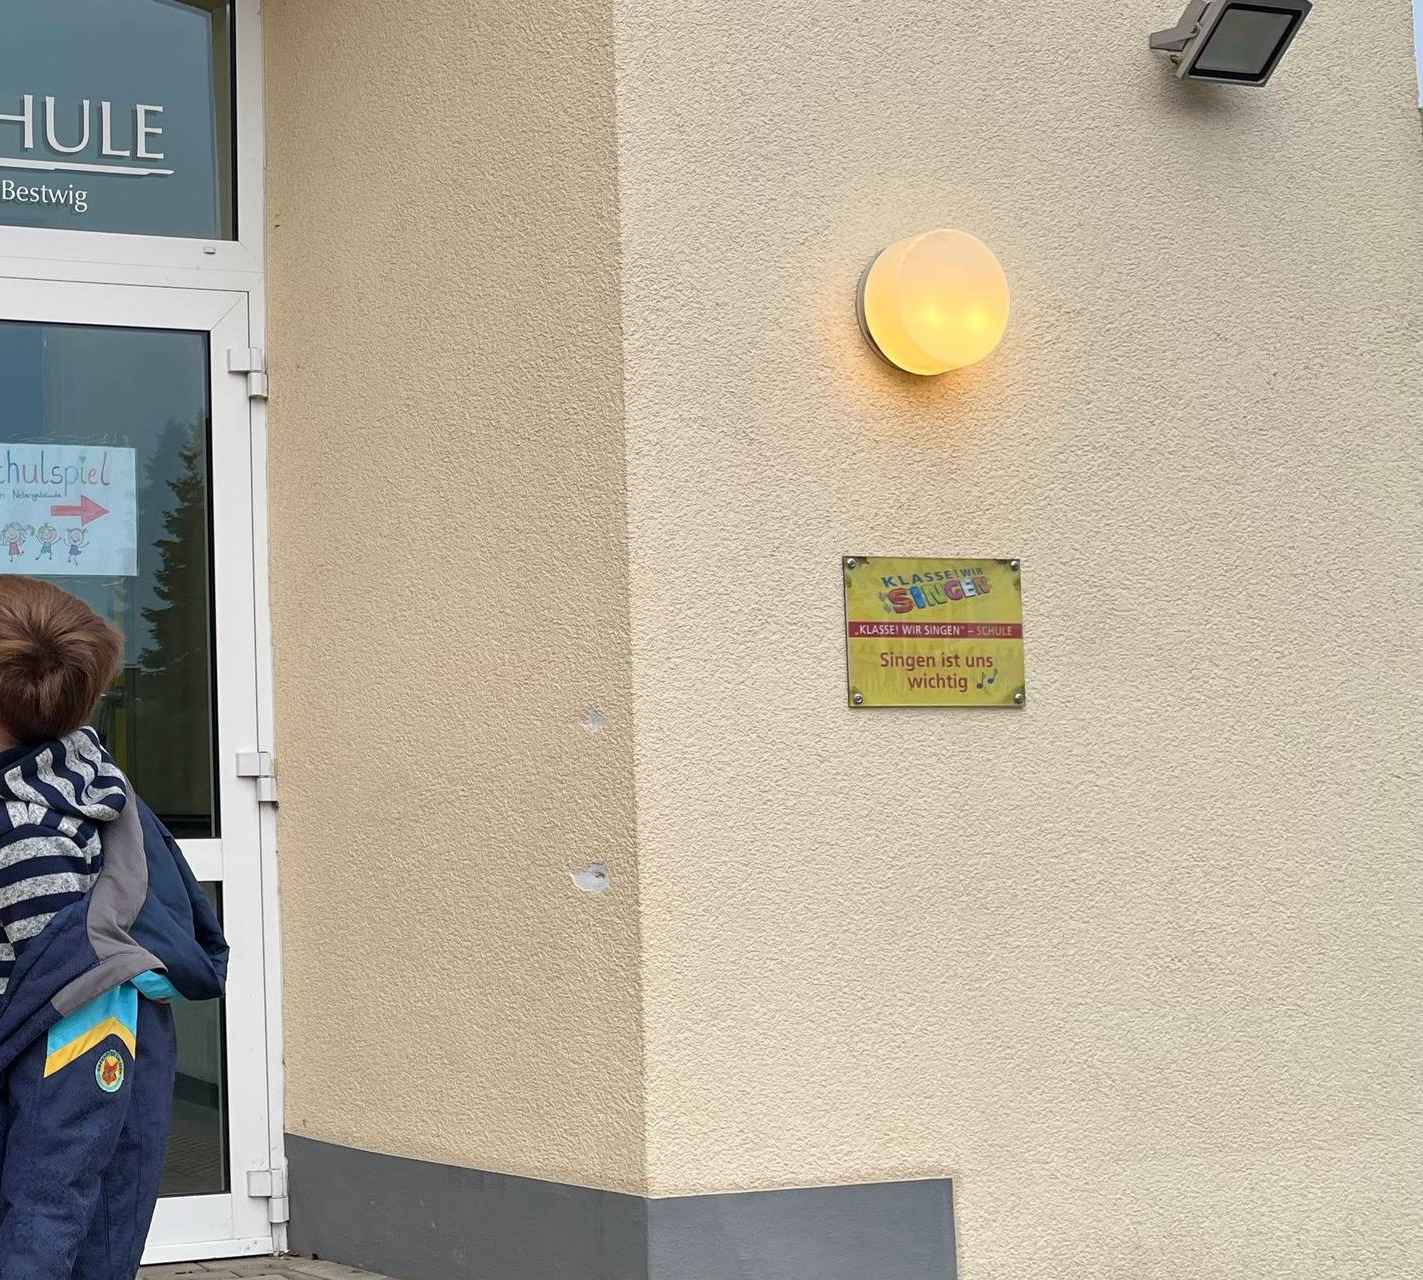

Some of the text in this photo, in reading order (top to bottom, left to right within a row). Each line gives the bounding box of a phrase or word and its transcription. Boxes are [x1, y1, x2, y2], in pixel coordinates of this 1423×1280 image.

[2, 179, 89, 212] Bestwig
[881, 567, 984, 588] KLASSE! WIR
[887, 575, 991, 614] SINGEN
[902, 624, 922, 635] WIR
[976, 625, 1013, 636] SCHULE
[880, 652, 994, 671] Singen ist uns
[907, 673, 968, 692] wichtig
